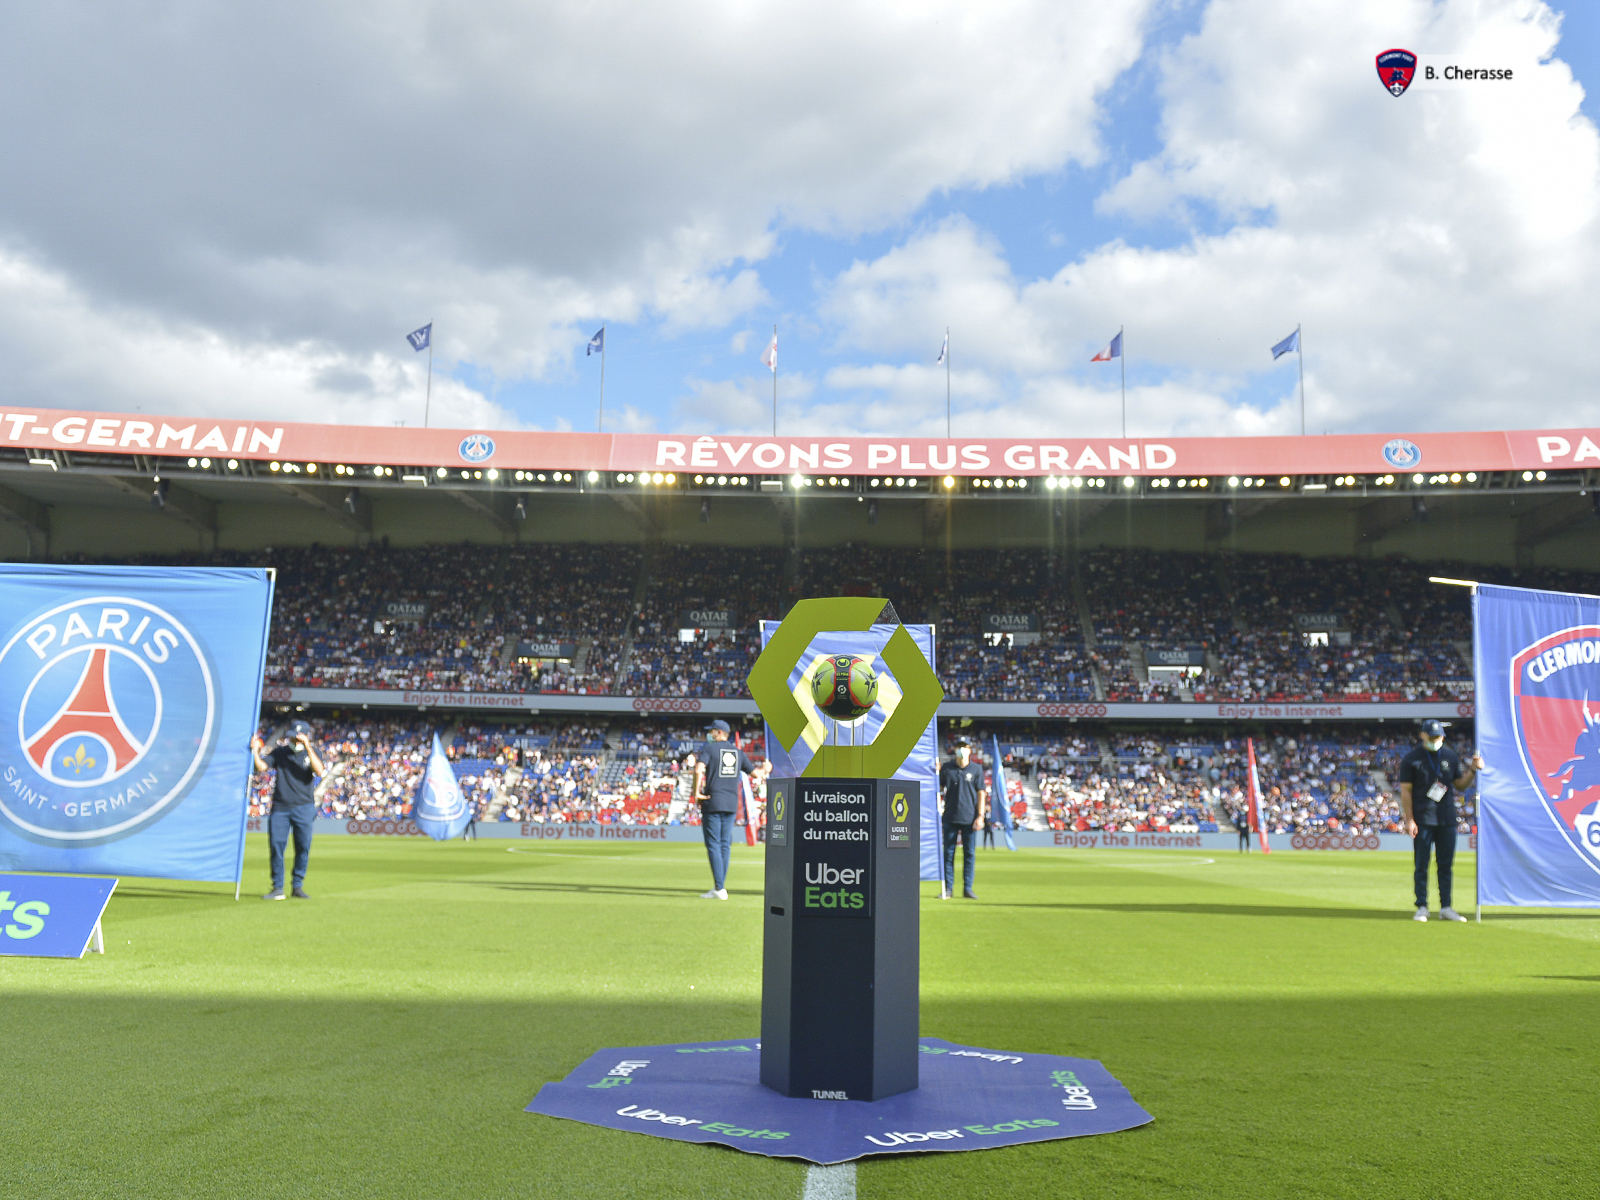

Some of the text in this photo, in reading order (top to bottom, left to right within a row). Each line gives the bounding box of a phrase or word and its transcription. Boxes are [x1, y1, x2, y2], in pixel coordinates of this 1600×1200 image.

[0, 413, 284, 454] T-GERMAIN
[655, 436, 1177, 471] RÊVONS PLUS GRAND
[690, 610, 728, 623] QATAR
[989, 614, 1029, 626] QATAR
[25, 608, 179, 664] PARIS
[531, 643, 560, 653] QATAR
[403, 692, 524, 706] Enjoy the Internet
[633, 698, 702, 712] ooredoo
[1038, 704, 1107, 717] ooredoo
[1218, 704, 1343, 719] Enjoy the Internet
[4, 766, 48, 810] SAINT
[64, 771, 159, 817] GERMAIN
[804, 791, 865, 804] Livraison
[803, 809, 868, 822] du ballon
[347, 818, 428, 836] ooredo
[520, 823, 666, 839] Enjoy the Internet
[803, 828, 869, 841] du match
[1054, 832, 1203, 848] Enjoy the Internet
[1291, 834, 1380, 850] ooredoo
[805, 862, 865, 885] Uber
[805, 886, 864, 909] Eats
[811, 1090, 848, 1100] TUNNEL
[1061, 1086, 1098, 1110] Uber
[616, 1104, 790, 1141] Uber Eats
[864, 1118, 1060, 1147] Uber Eats
